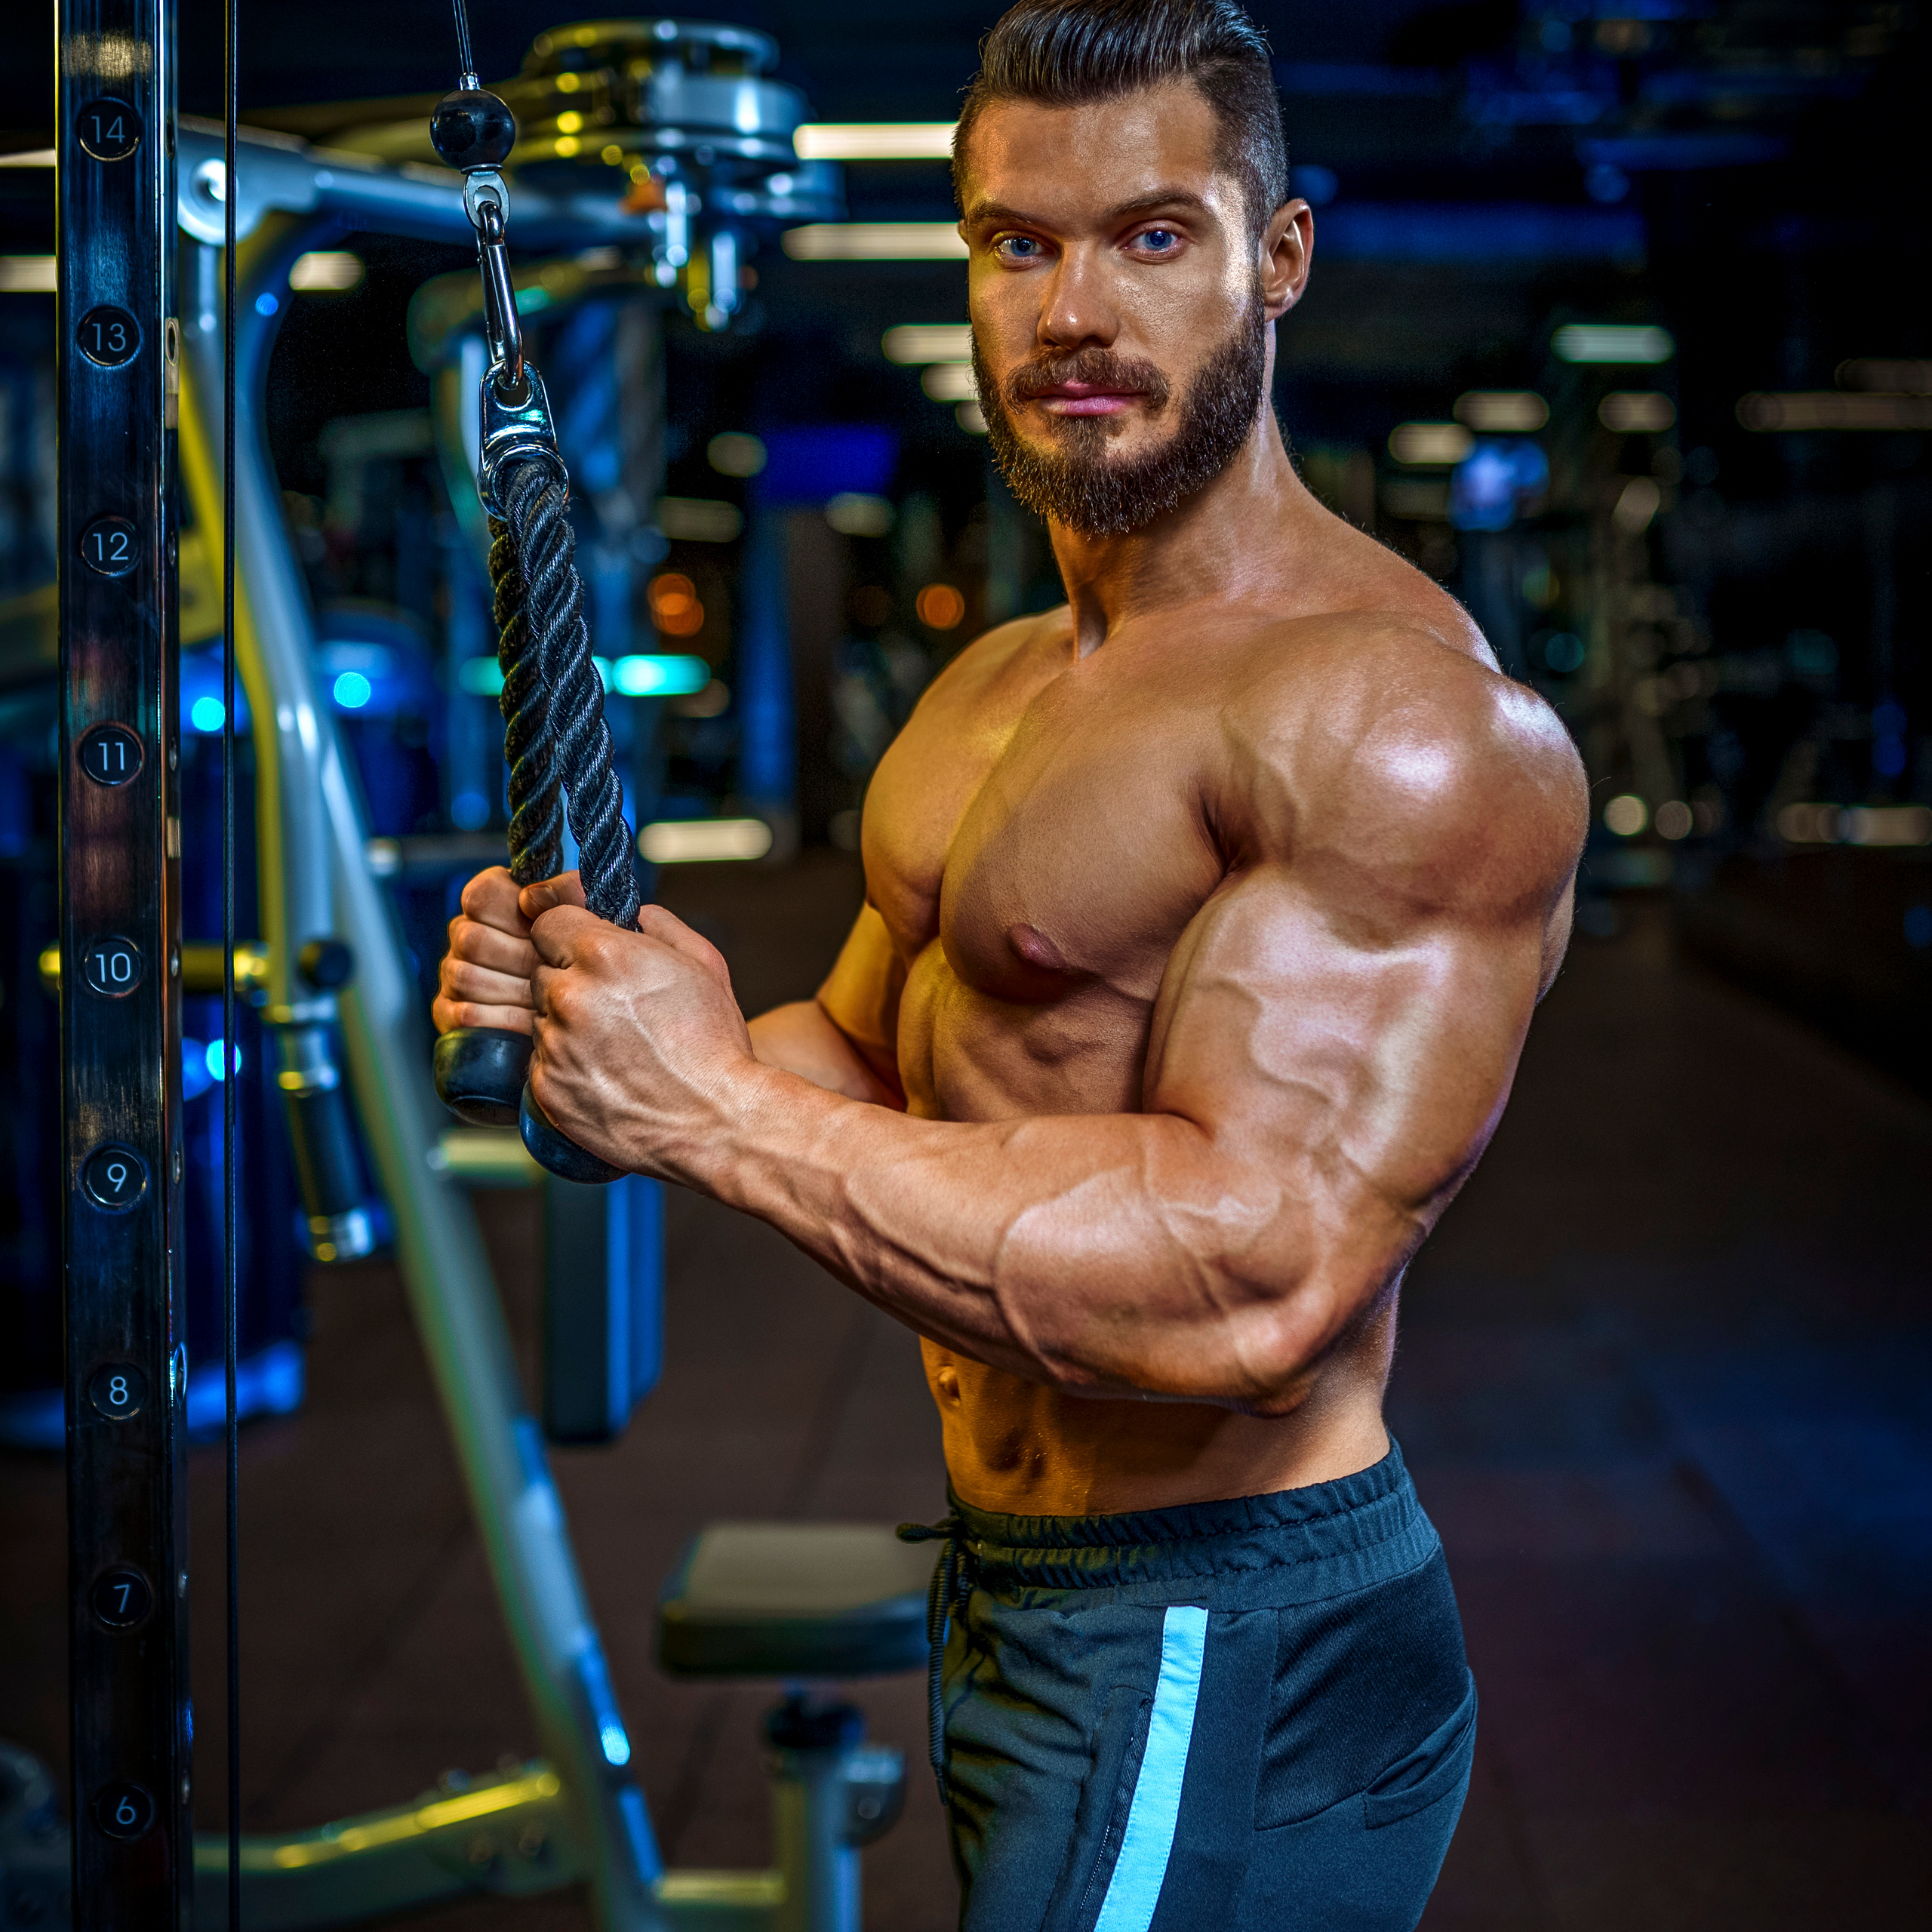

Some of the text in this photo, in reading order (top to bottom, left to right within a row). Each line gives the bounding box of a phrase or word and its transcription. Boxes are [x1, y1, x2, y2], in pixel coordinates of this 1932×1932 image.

[91, 115, 125, 143] 14
[92, 323, 126, 352] 13
[93, 532, 129, 561] 12
[98, 742, 125, 771] 11
[96, 952, 131, 982] 10
[107, 1163, 127, 1192] 9
[109, 1376, 128, 1405] 8
[114, 1583, 131, 1613] 7
[116, 1796, 137, 1825] 6
